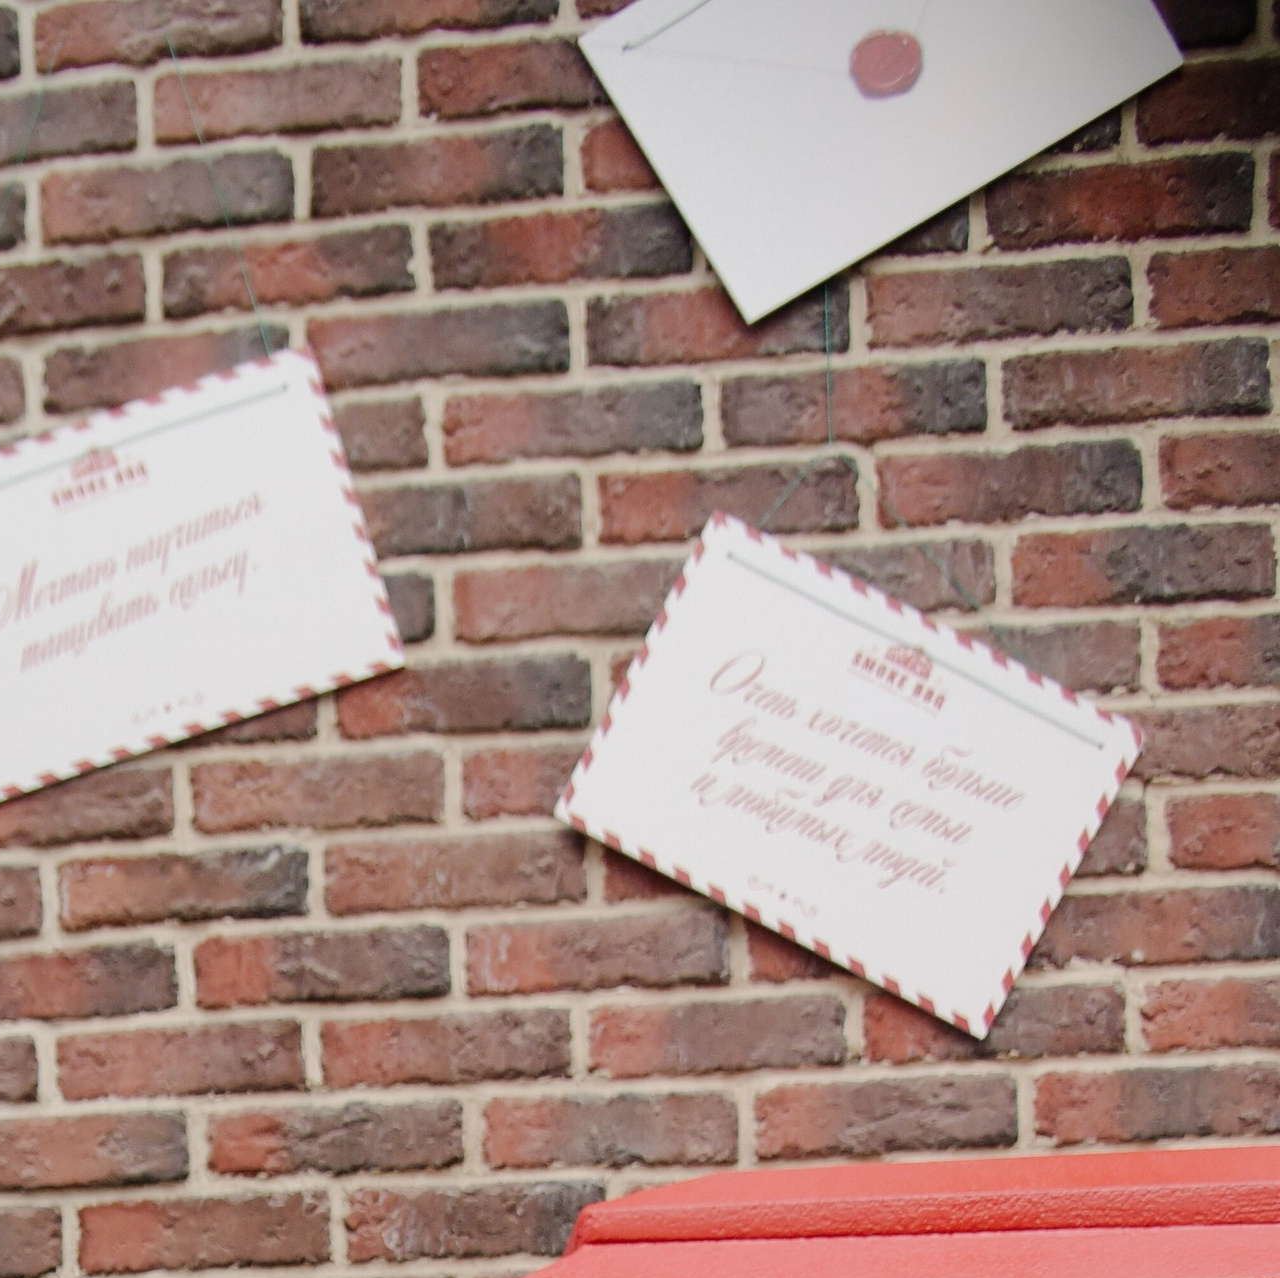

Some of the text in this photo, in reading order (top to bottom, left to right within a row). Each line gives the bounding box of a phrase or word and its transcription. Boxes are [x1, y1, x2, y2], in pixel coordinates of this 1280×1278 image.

[125, 491, 263, 577] научиться
[20, 549, 261, 673] танцевать сальсу.
[850, 650, 909, 690] SMOKE
[709, 652, 1024, 812] Очень хочется больше
[711, 716, 973, 843] времени для семьи
[723, 782, 850, 863] любимых
[861, 840, 958, 894] людей.
